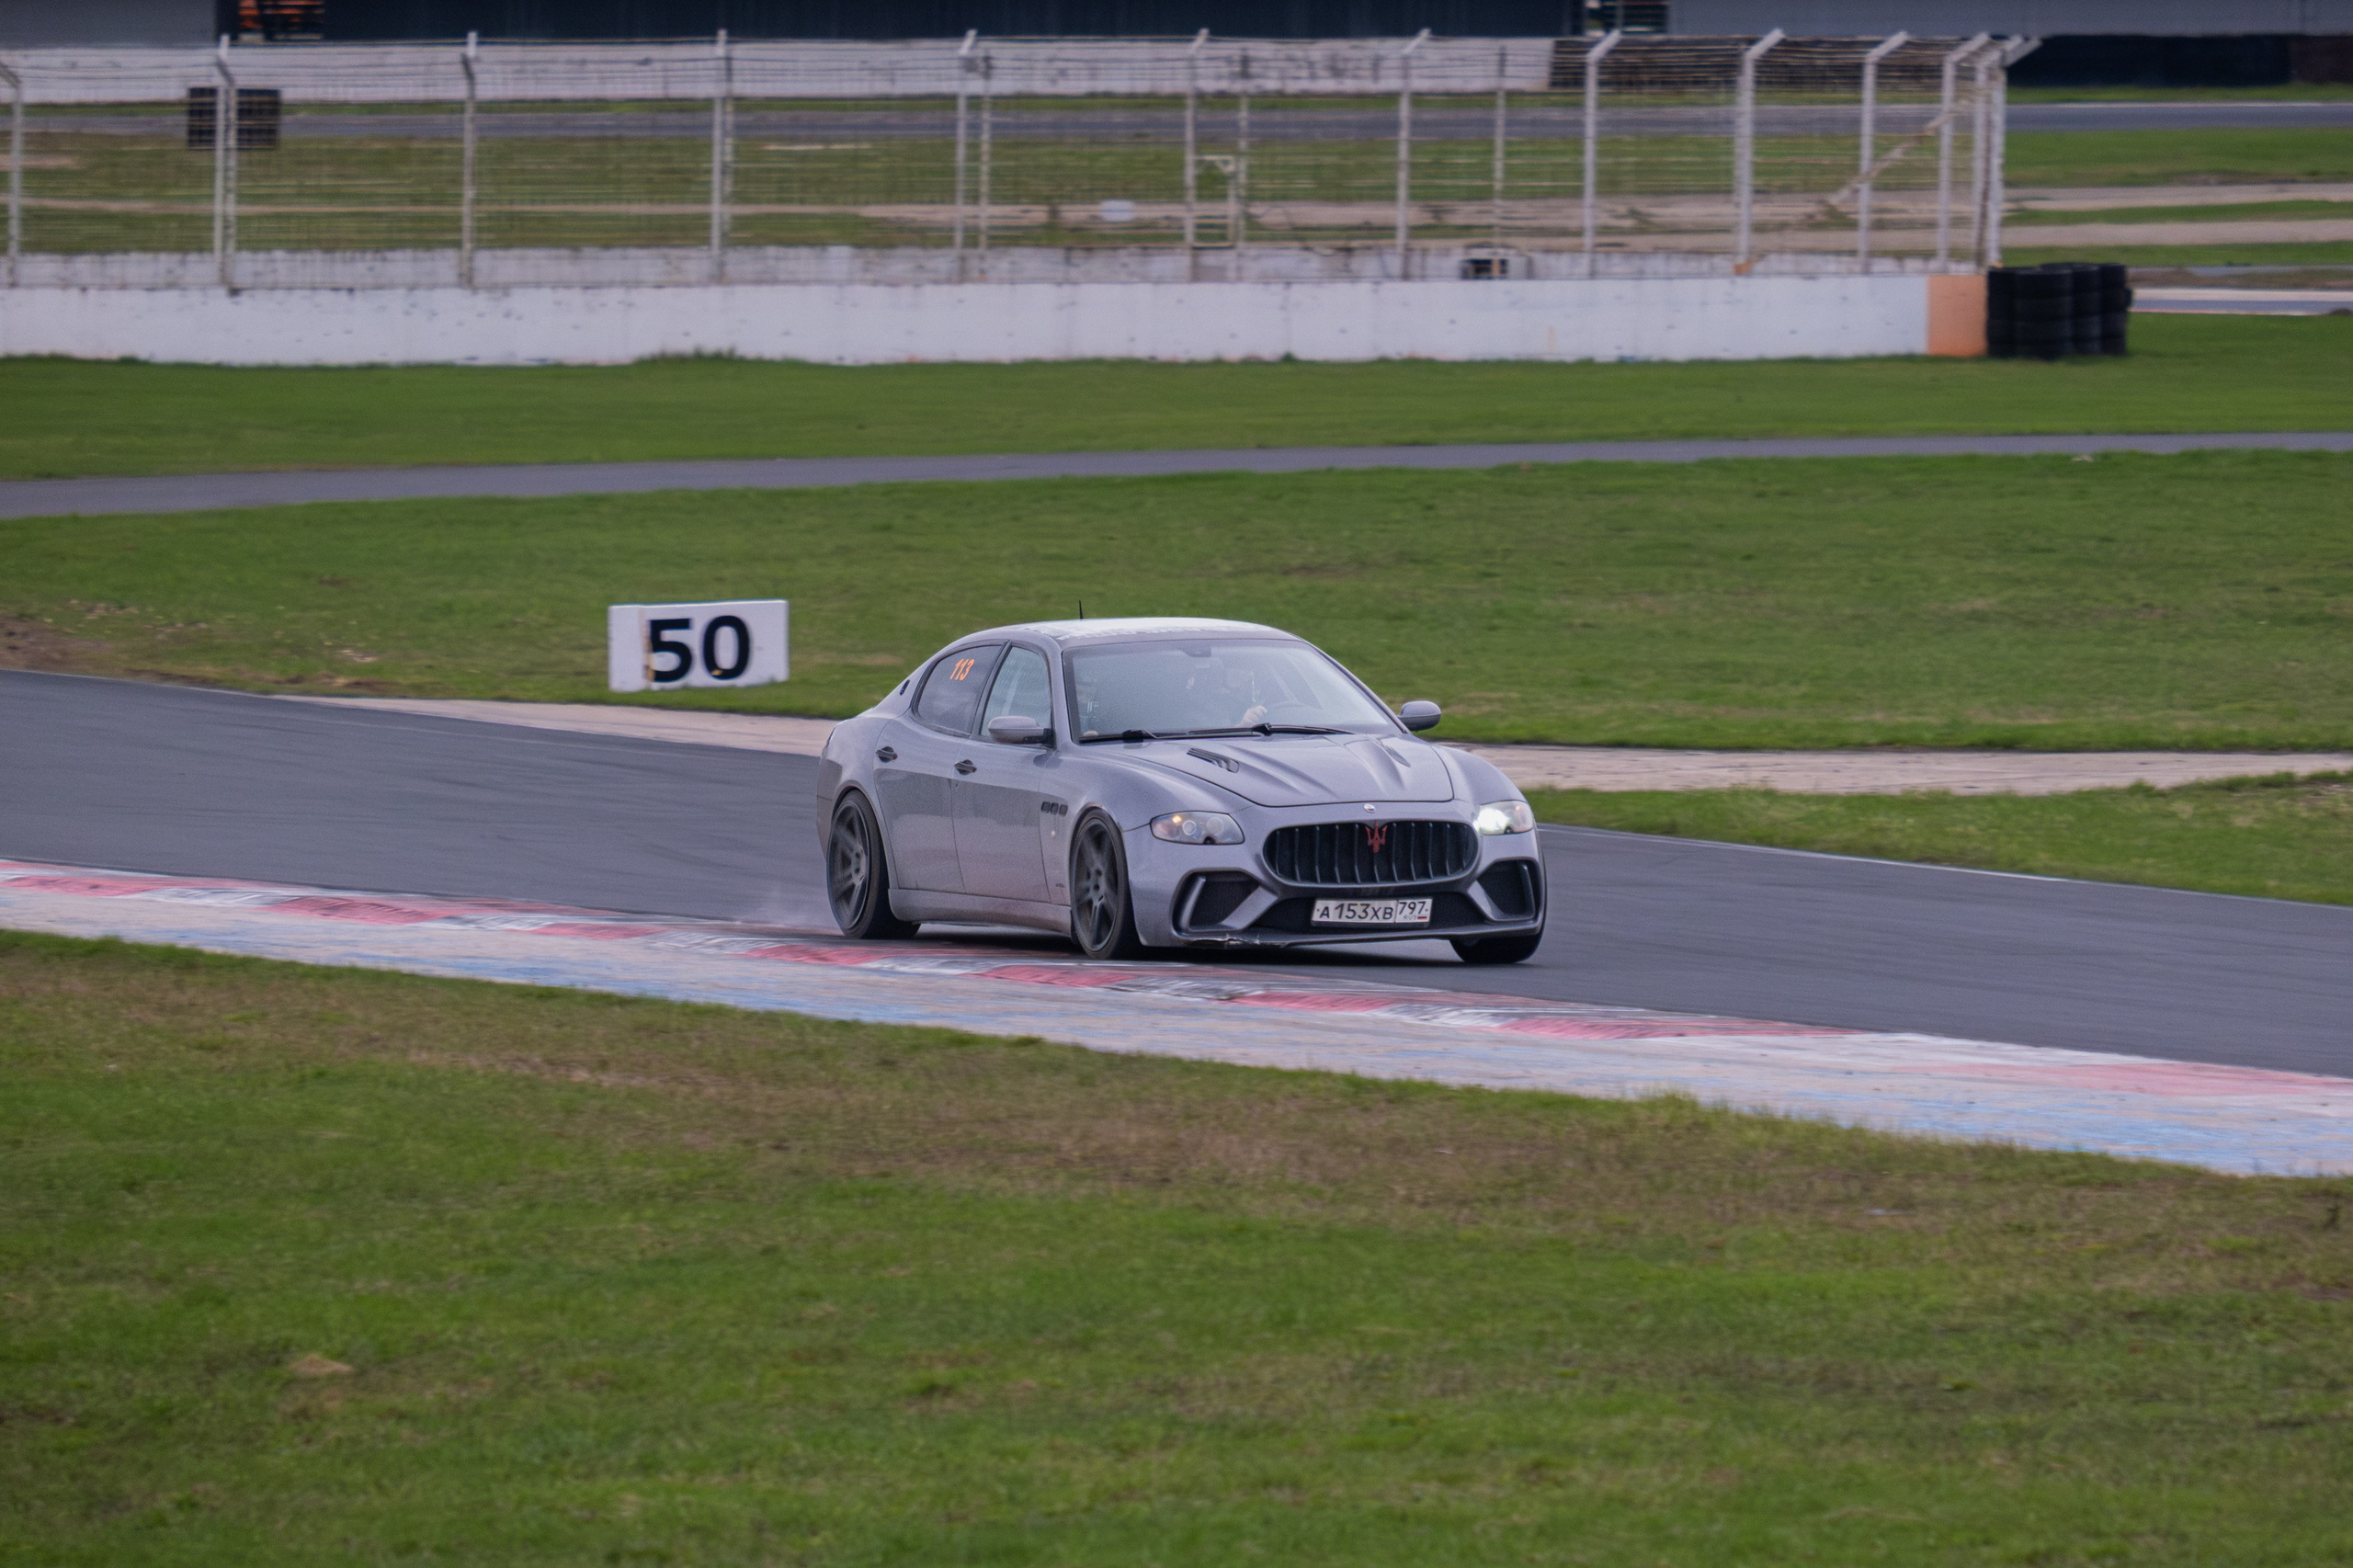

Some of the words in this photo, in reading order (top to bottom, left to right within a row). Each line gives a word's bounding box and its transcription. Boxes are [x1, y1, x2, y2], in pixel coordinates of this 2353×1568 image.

[645, 615, 750, 683] 50
[949, 658, 974, 681] 113
[1398, 901, 1426, 915] 797
